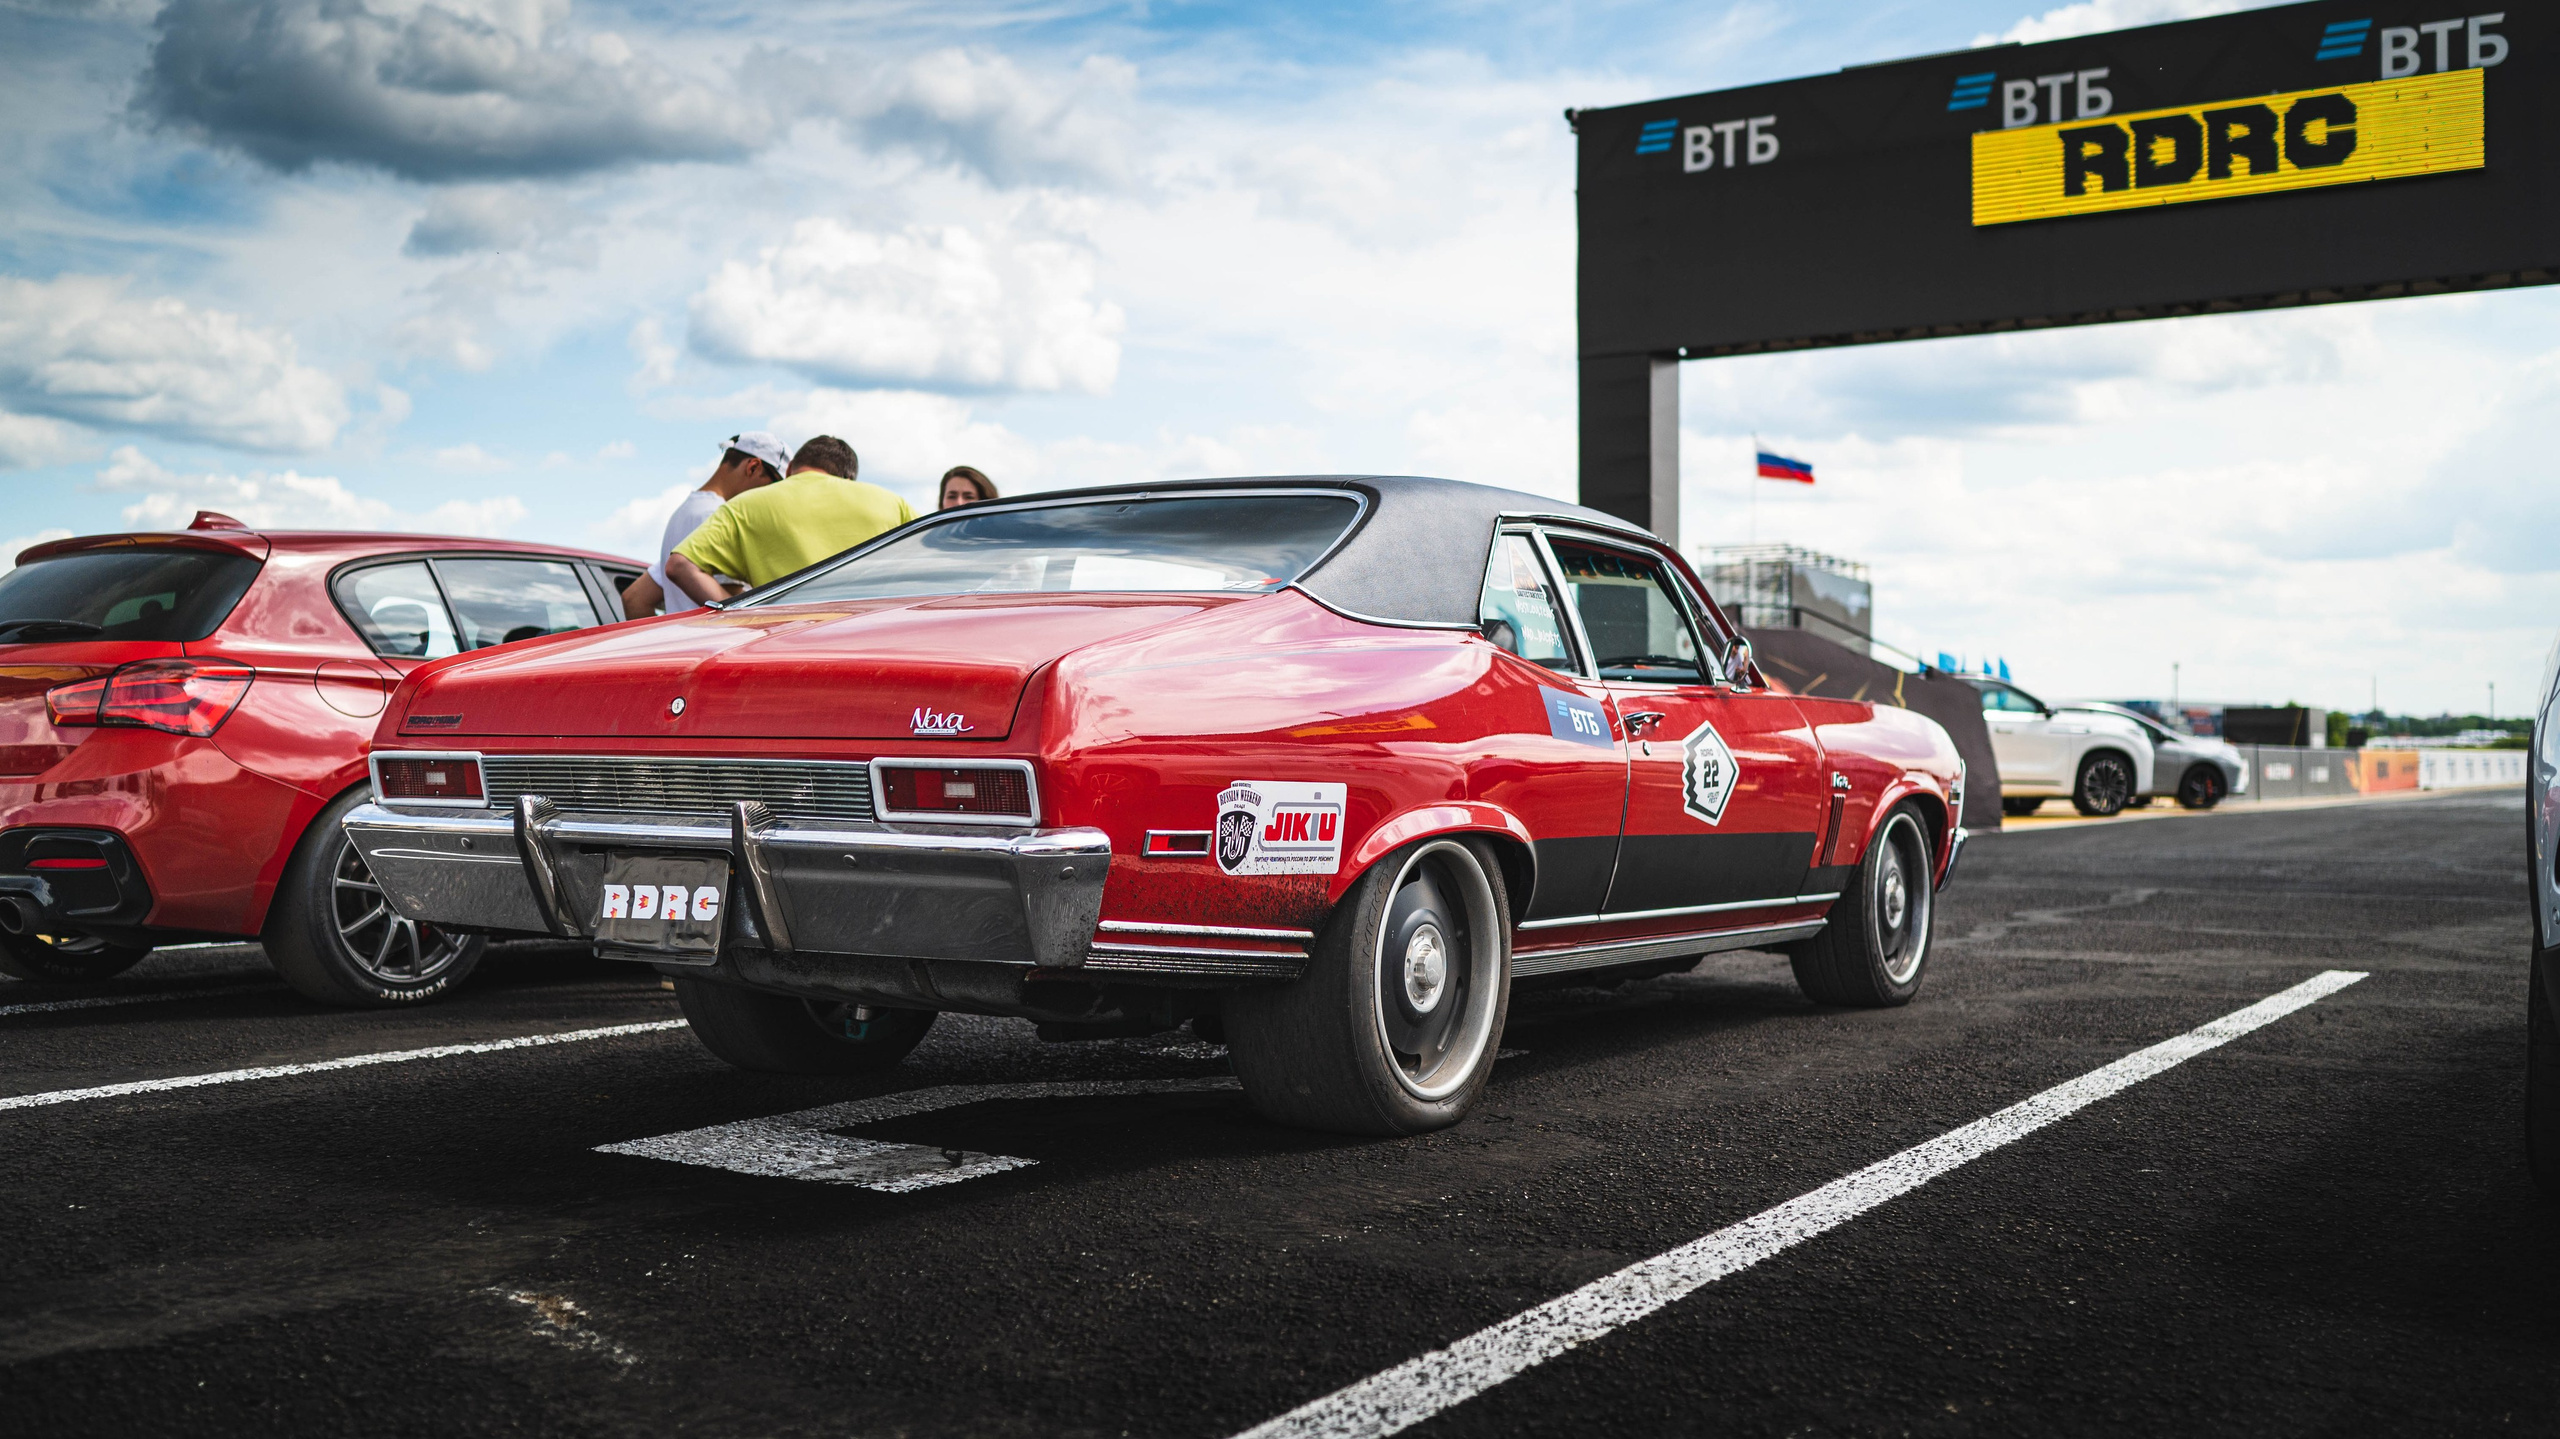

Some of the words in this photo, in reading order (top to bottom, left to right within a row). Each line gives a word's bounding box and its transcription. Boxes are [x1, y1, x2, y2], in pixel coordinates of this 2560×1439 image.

[2381, 11, 2509, 80] ВТБ
[2002, 66, 2113, 129] ВТБ
[1683, 114, 1780, 174] ВТБ
[2058, 93, 2358, 197] RDRC
[909, 707, 974, 732] Nova
[1569, 707, 1600, 736] ВТБ
[1703, 759, 1719, 789] 22
[1240, 789, 1262, 807] WEEKEND
[1264, 812, 1337, 841] JIKIU
[602, 884, 720, 922] RDRC
